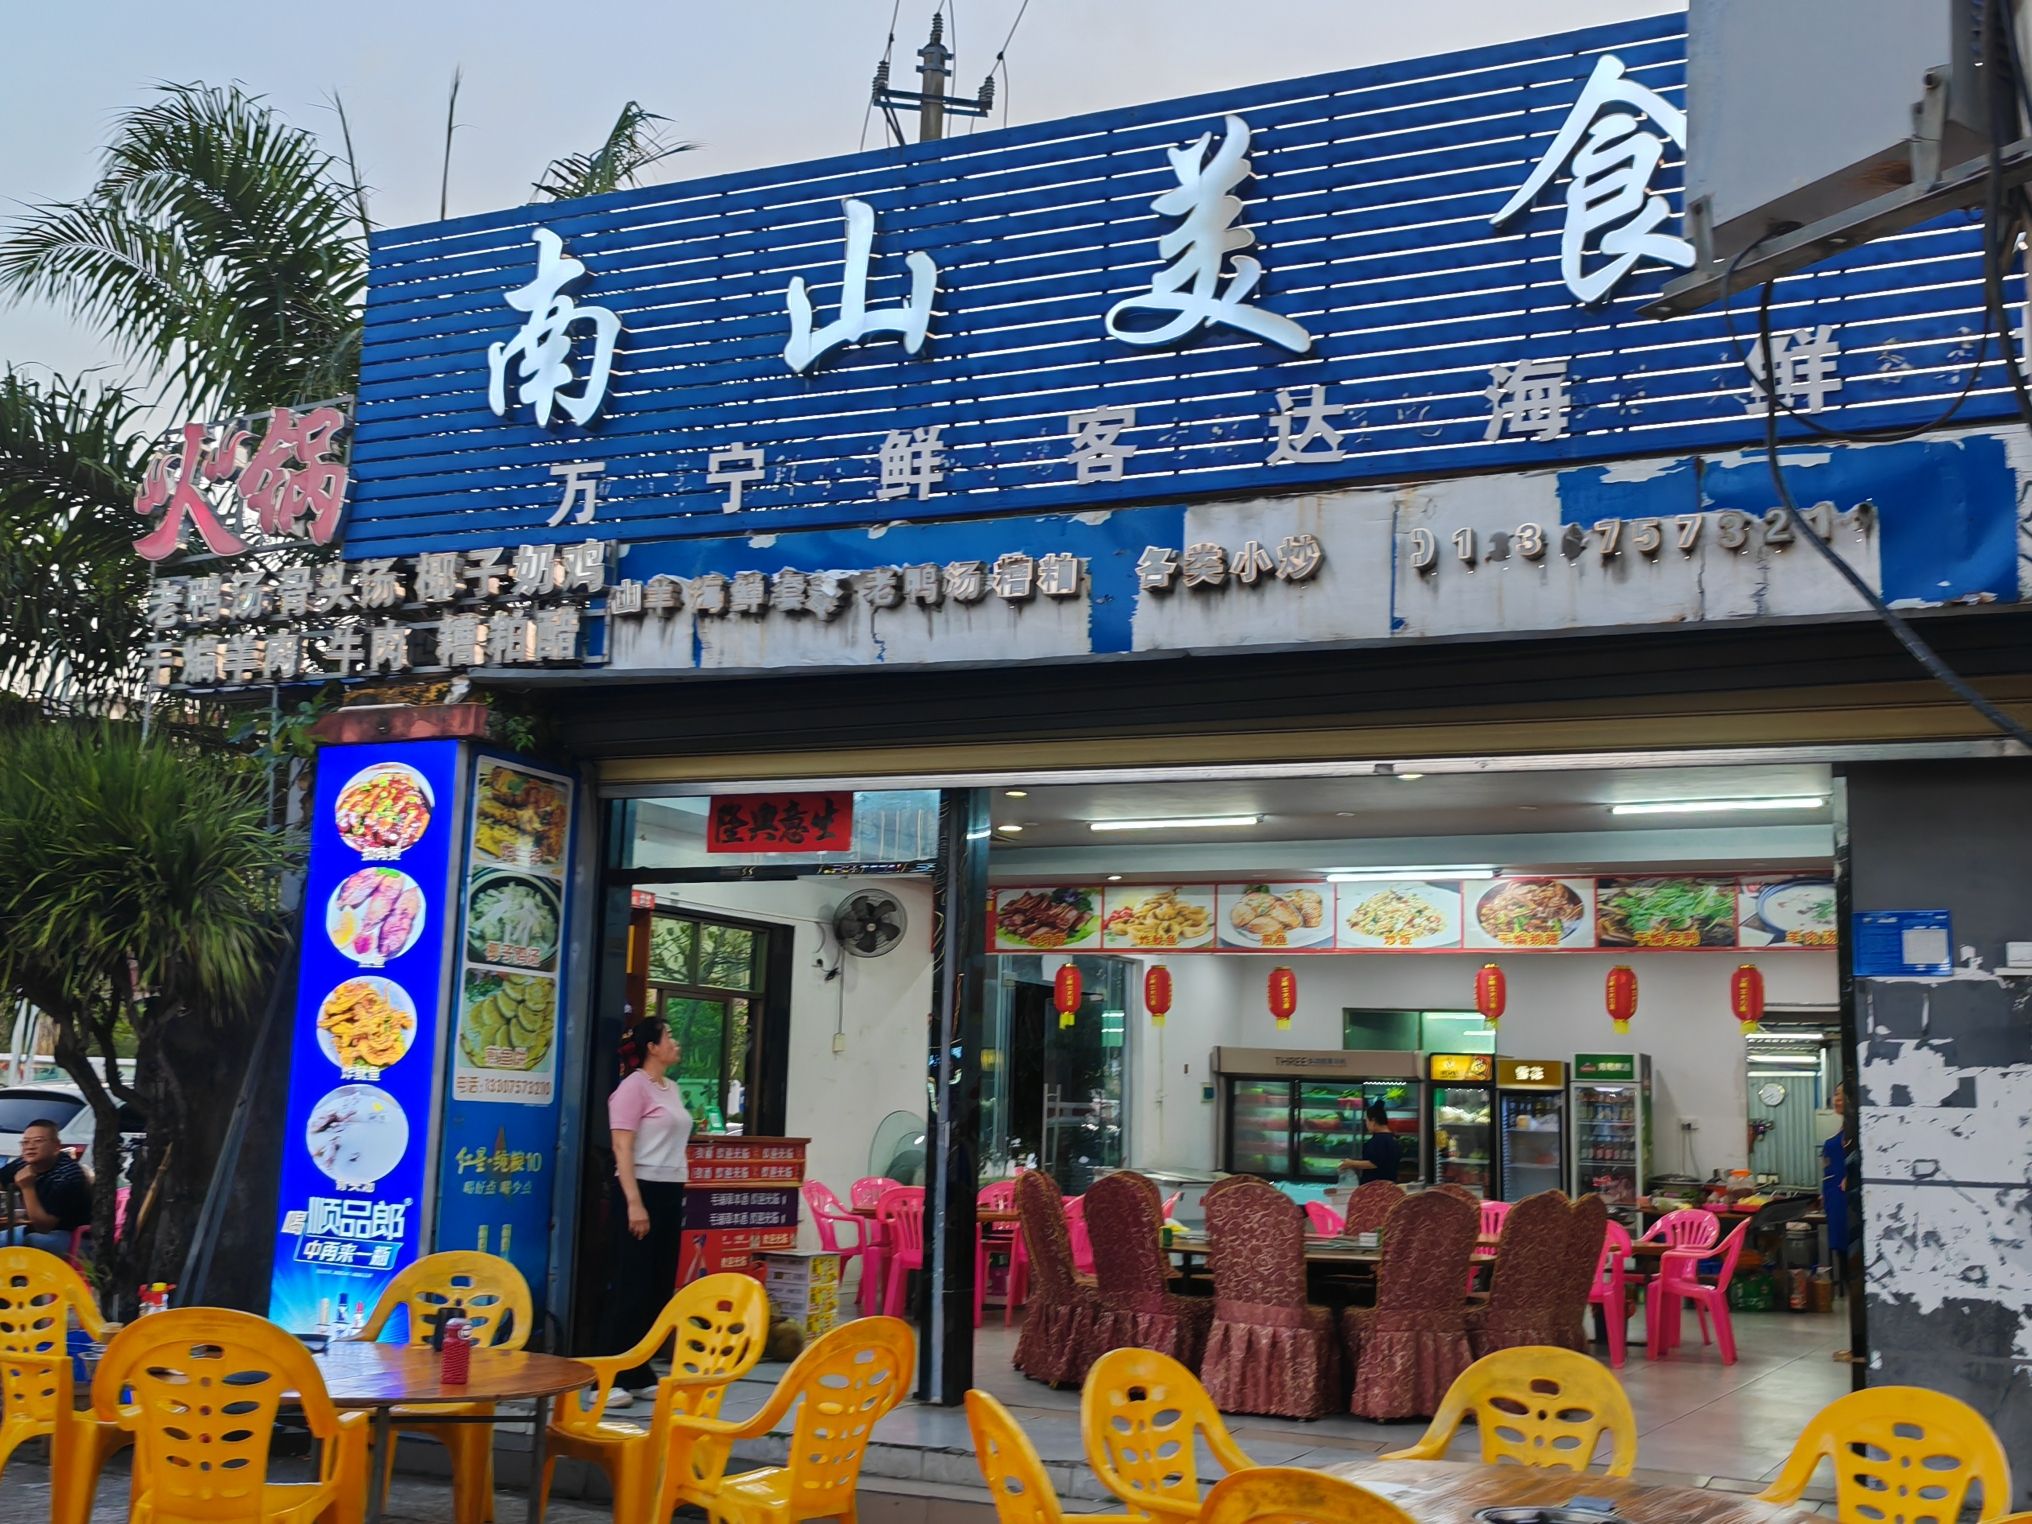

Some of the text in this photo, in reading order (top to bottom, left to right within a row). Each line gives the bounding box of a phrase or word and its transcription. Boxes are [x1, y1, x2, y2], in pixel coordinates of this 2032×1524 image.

[487, 54, 1697, 430] 南山美食
[133, 405, 350, 562] 火锅
[1137, 532, 1324, 592] 各类小炒
